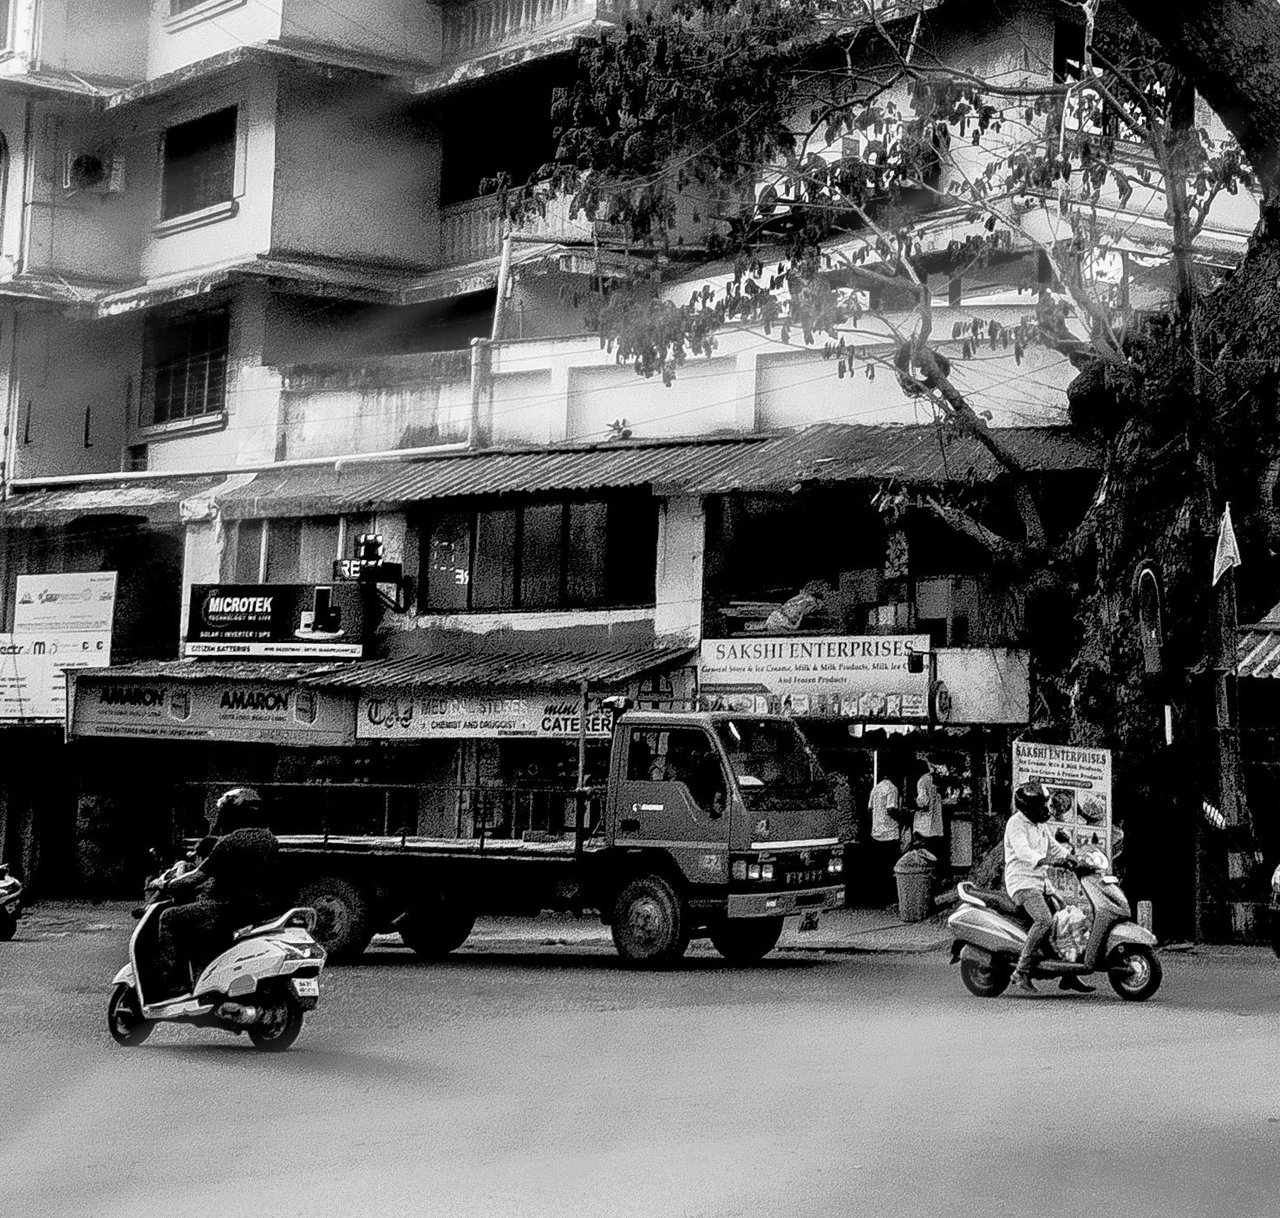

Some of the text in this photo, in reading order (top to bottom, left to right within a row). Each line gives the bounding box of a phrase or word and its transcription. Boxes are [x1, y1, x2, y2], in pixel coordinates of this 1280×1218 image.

[208, 597, 273, 613] MICROTEK
[716, 640, 914, 660] SAKSHI ENTERPRISES
[795, 663, 810, 671] Milk
[818, 675, 847, 683] Products
[100, 686, 164, 706] AMARON
[220, 690, 289, 711] AMARON
[544, 700, 580, 715] mini
[431, 720, 516, 730] CHEMIST AND DRUGGIST
[1015, 744, 1107, 765] SAKSHI ENTERPRISES
